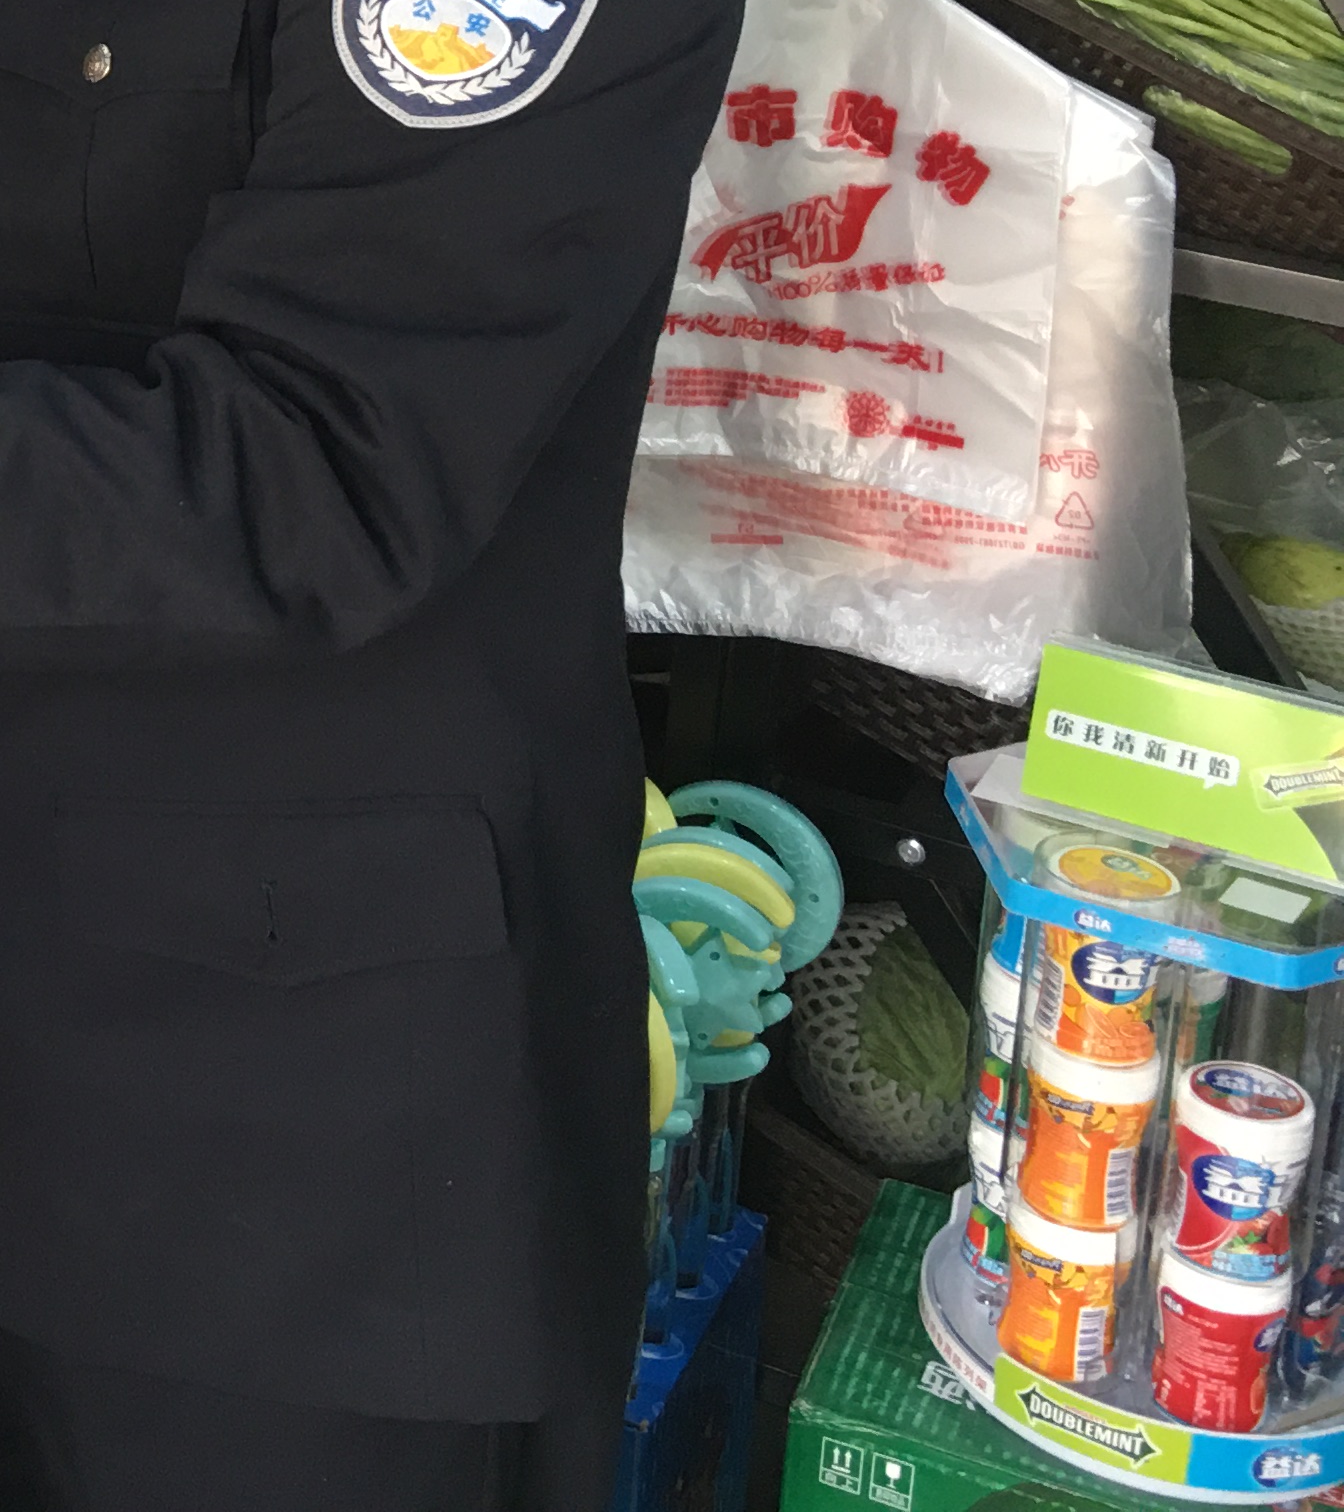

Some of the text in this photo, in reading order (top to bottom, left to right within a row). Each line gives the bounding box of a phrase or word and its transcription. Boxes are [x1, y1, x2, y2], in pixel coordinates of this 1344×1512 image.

[464, 11, 492, 38] 安
[1051, 714, 1233, 781] 你我清新开始
[1270, 764, 1344, 792] DOUBLEMINT
[1029, 1394, 1145, 1457] DOUBLEMINT
[1258, 1452, 1322, 1480] 益达
